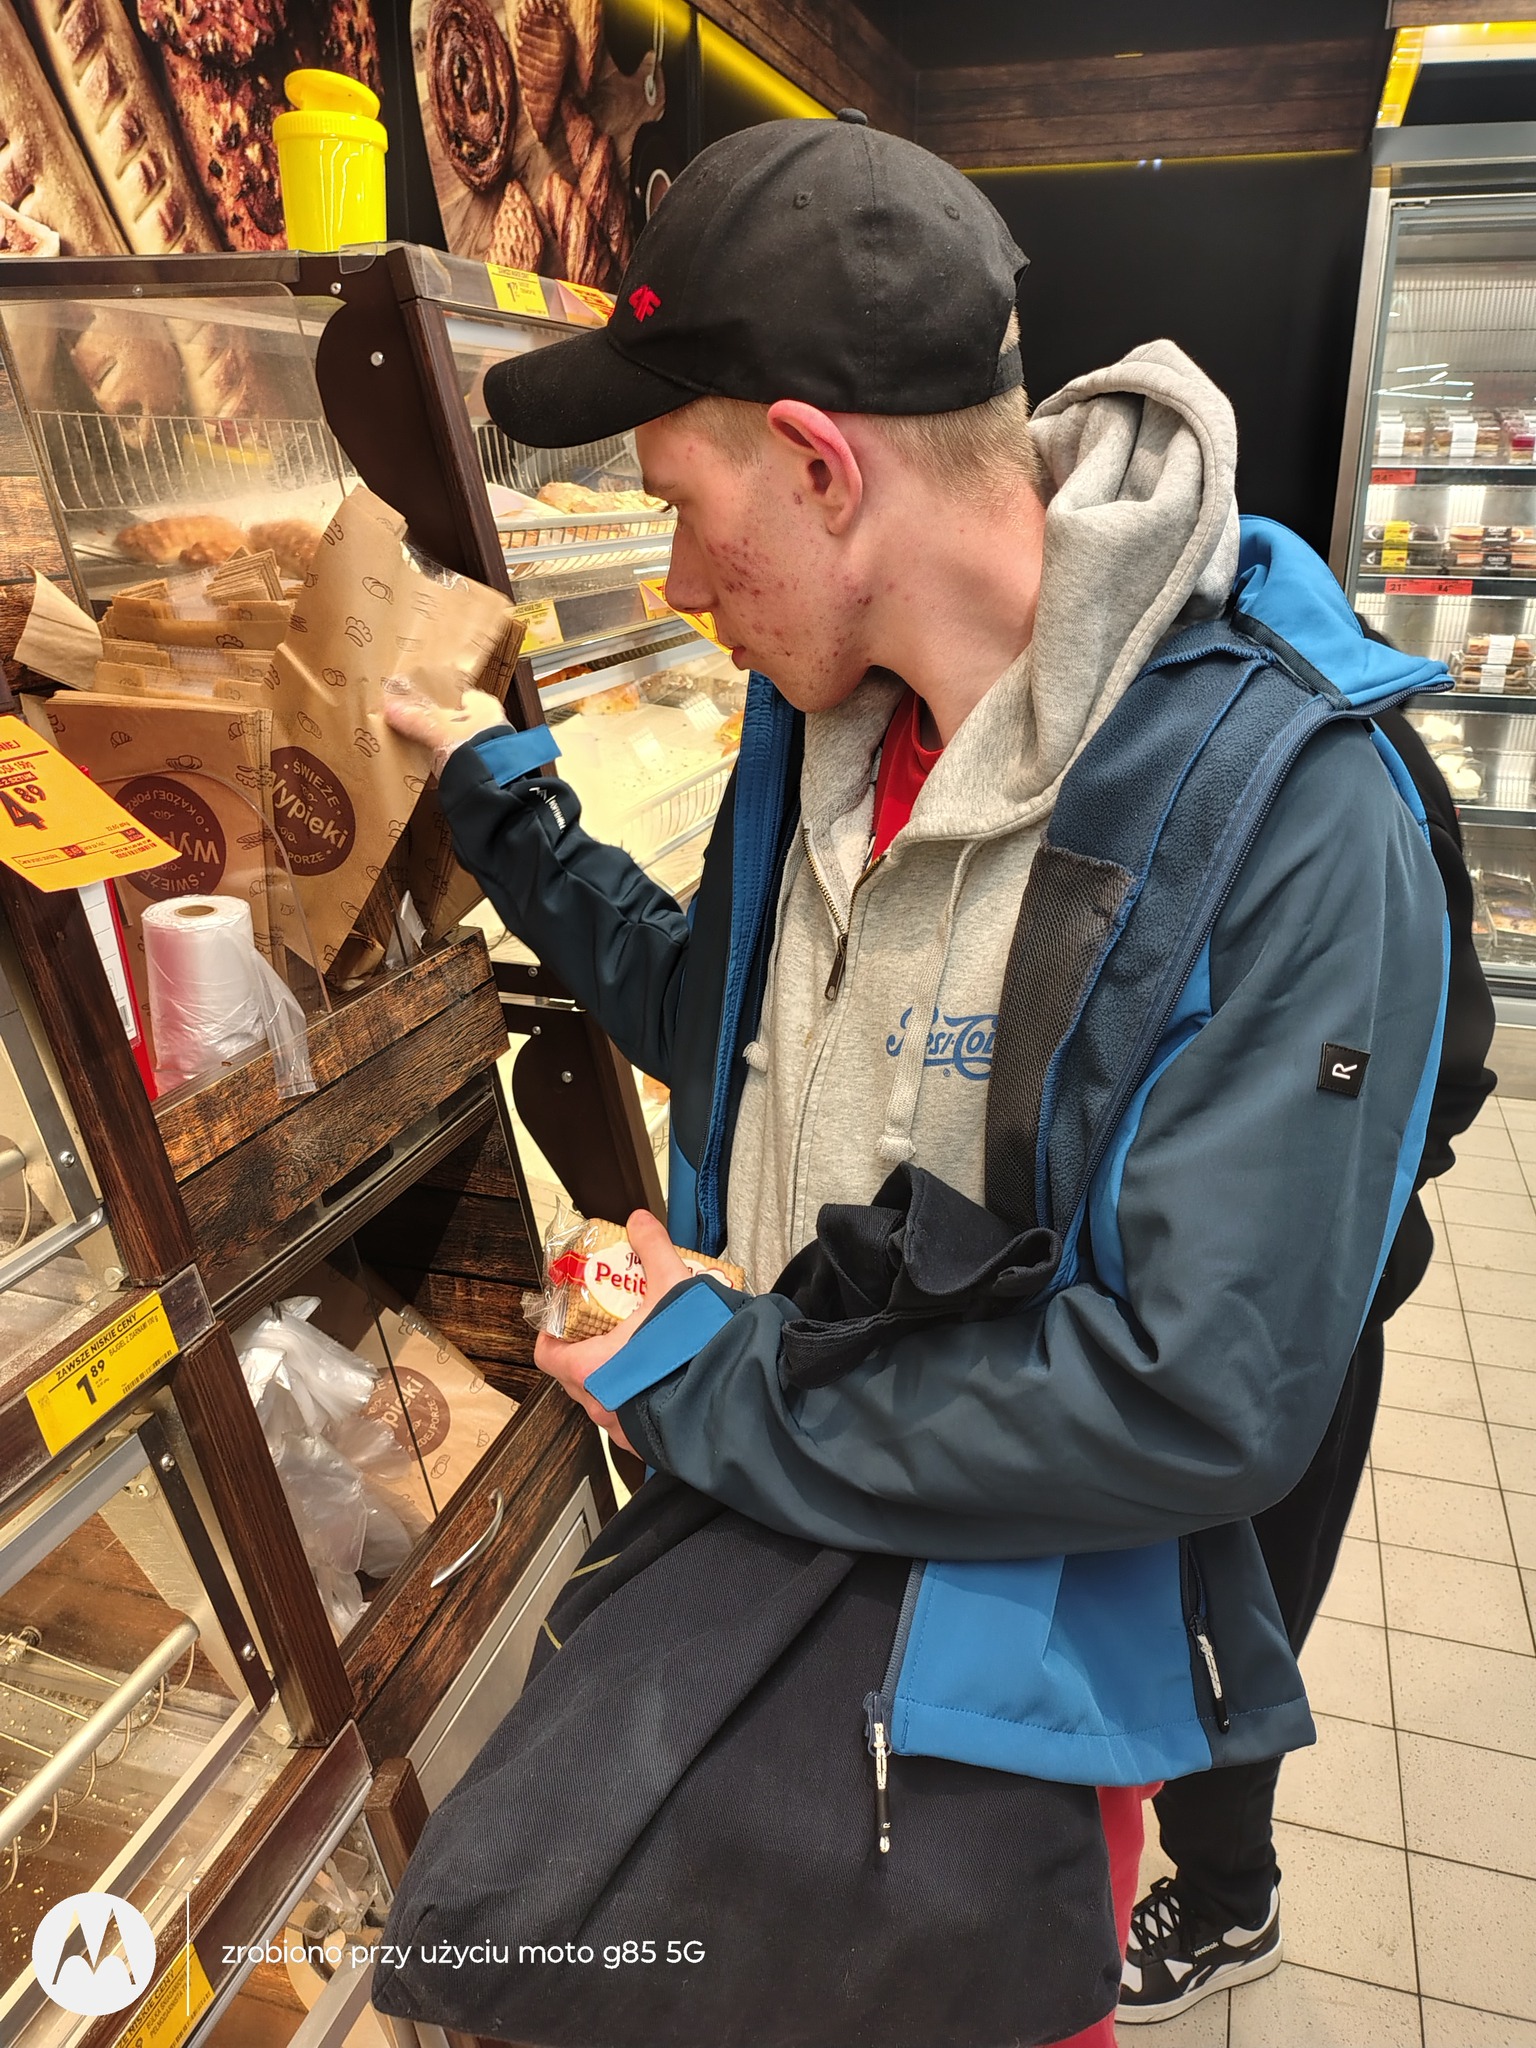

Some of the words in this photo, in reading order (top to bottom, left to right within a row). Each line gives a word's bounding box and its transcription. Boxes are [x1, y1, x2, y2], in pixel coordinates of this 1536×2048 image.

[125, 790, 152, 812] PORZ
[292, 758, 340, 808] ŚWIEŻE
[287, 850, 326, 865] PORZE
[1332, 1063, 1358, 1081] R
[55, 1348, 91, 1382] ZAWSZE
[91, 1328, 117, 1354] NISKIE
[116, 1311, 138, 1333] CENY
[381, 1375, 424, 1429] pieki
[128, 1997, 156, 2036] NISKIE
[154, 1968, 176, 2000] CENY
